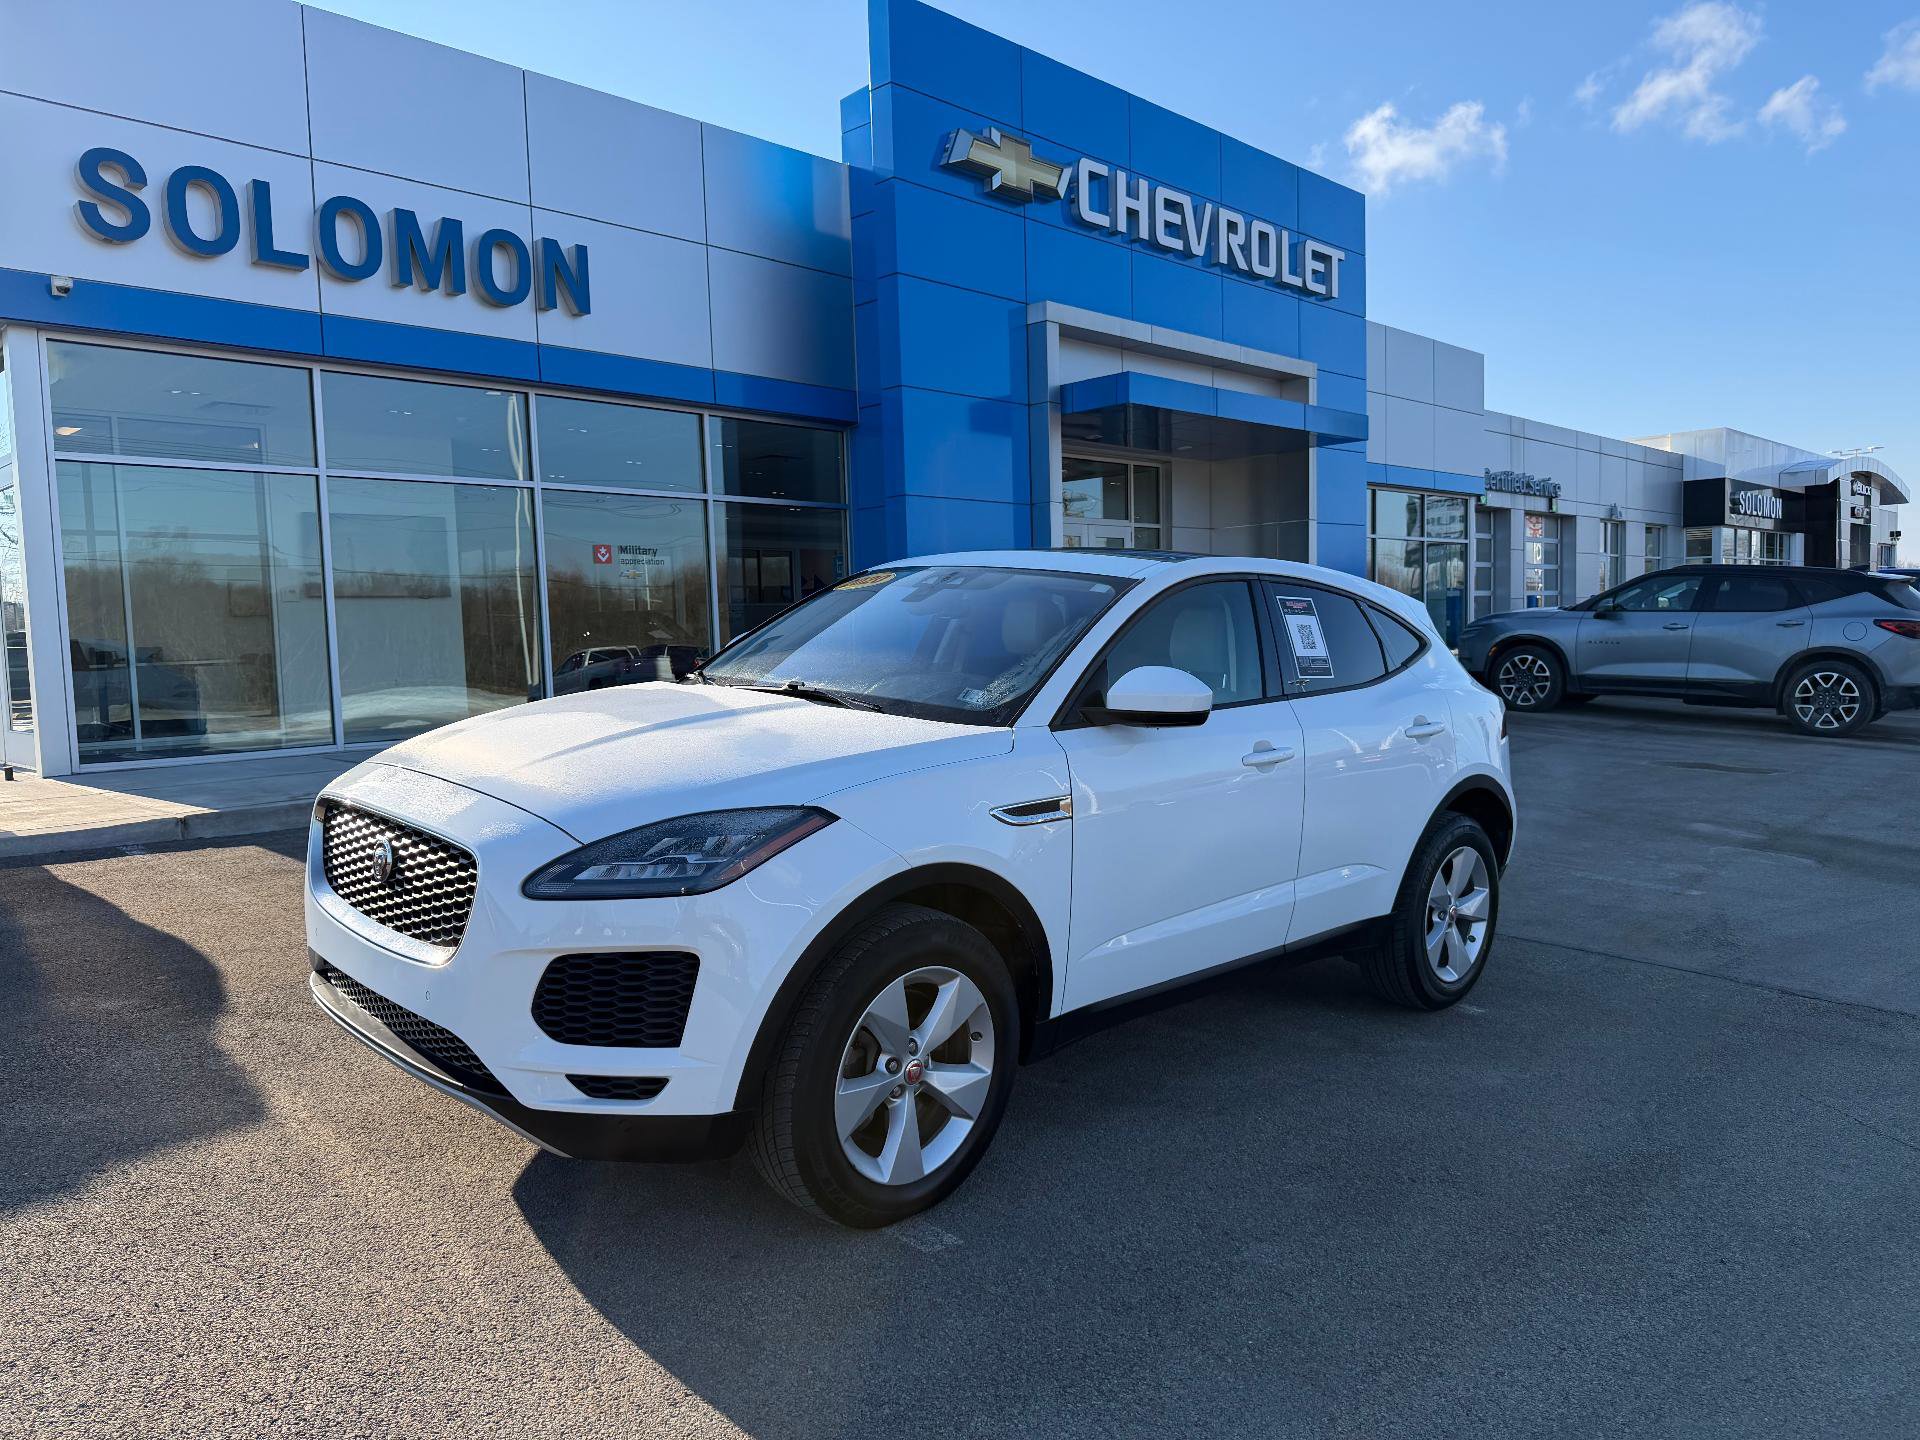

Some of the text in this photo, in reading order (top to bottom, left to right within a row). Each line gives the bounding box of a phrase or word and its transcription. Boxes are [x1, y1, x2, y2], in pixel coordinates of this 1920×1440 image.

[73, 147, 591, 316] SOLOMON
[1076, 157, 1345, 299] CHEVROLET
[1484, 468, 1561, 498] Certified Service
[1739, 490, 1783, 519] SOLOMON
[619, 544, 658, 557] Military
